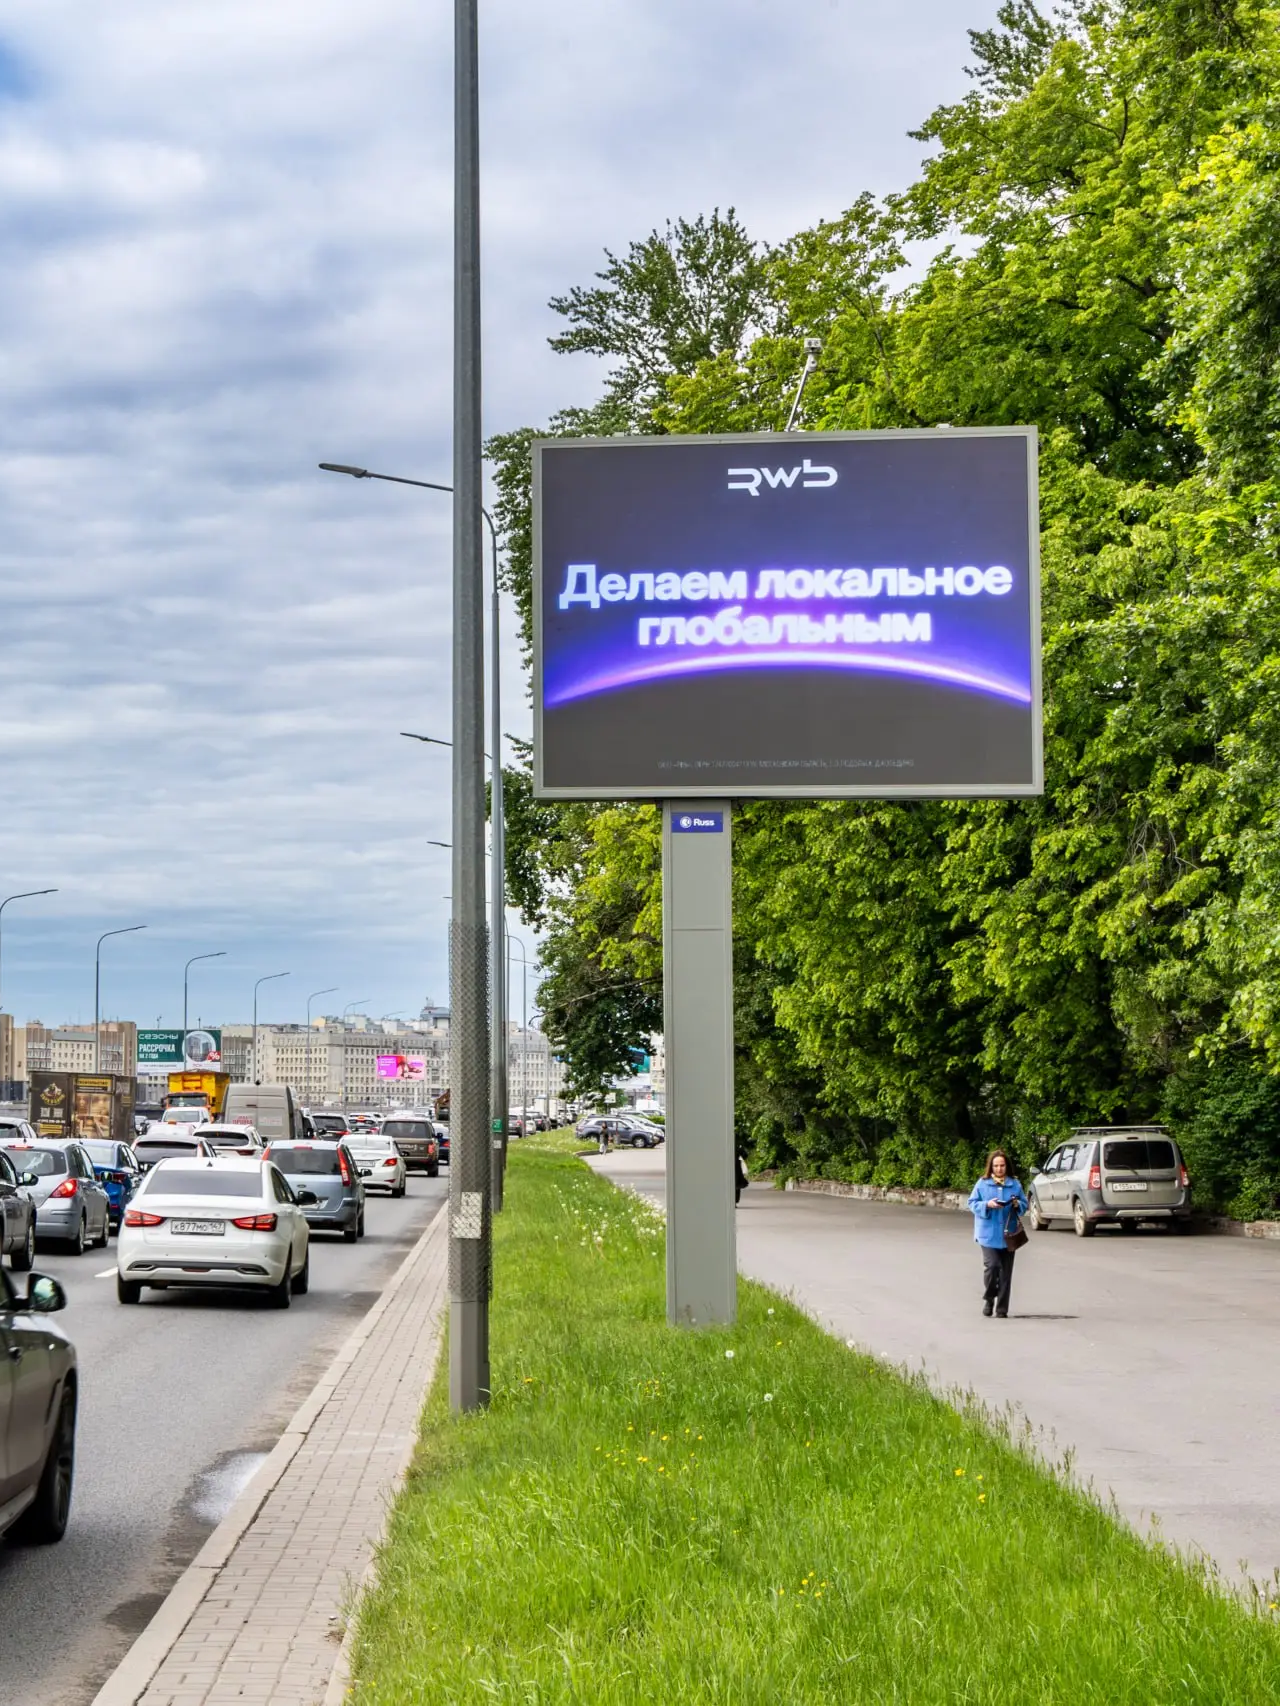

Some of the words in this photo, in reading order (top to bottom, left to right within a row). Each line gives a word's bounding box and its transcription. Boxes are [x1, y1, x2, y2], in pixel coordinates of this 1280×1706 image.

[558, 563, 748, 609] Делаем
[753, 565, 1014, 599] локальное
[637, 606, 933, 645] глобальным
[693, 818, 715, 826] Russ
[138, 1043, 176, 1053] РАССРОЧКА
